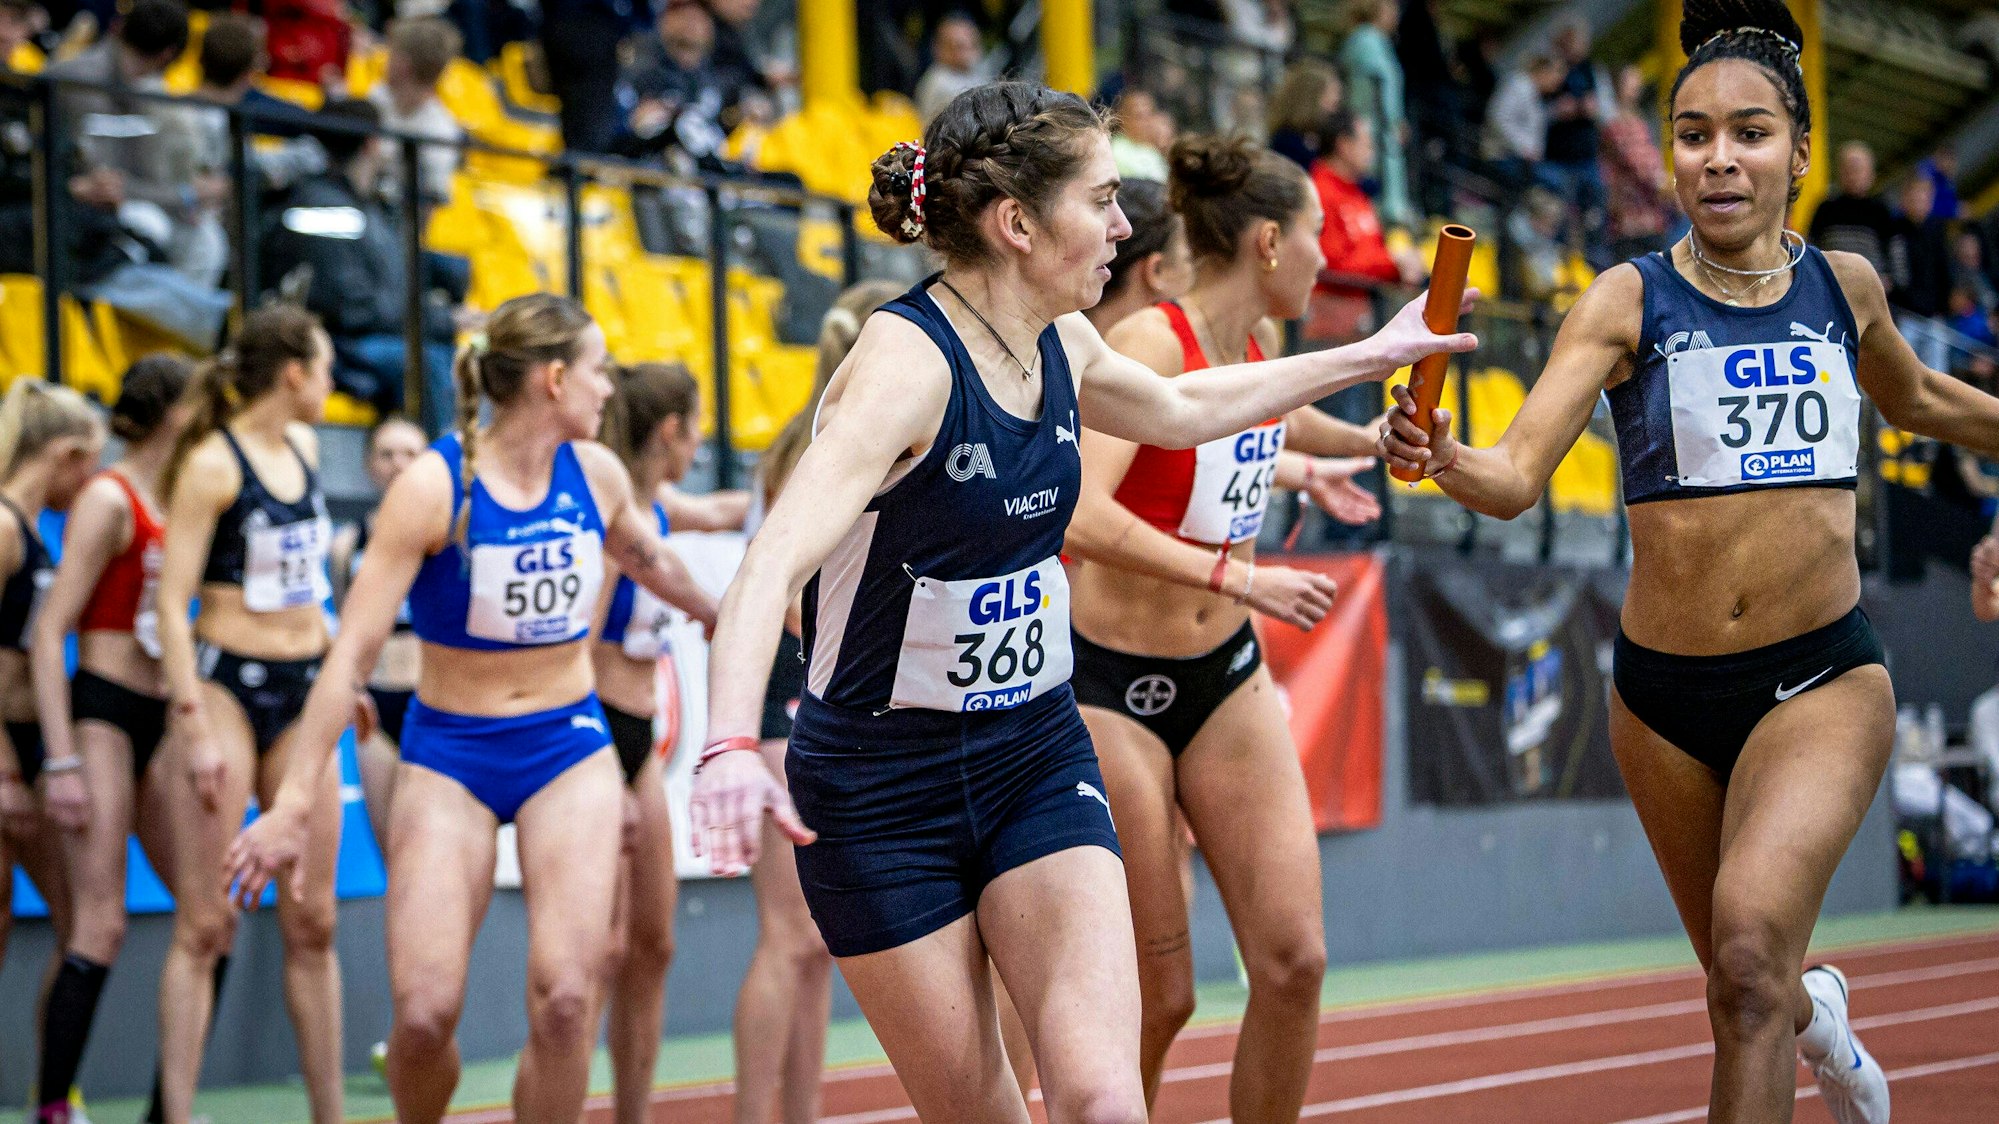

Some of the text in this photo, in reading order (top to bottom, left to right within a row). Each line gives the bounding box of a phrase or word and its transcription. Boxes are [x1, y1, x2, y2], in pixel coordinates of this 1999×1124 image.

[1718, 390, 1830, 449] 370
[1770, 453, 1812, 469] PLAN
[1004, 486, 1059, 517] VIACTIV
[504, 572, 580, 617] 509
[946, 618, 1045, 688] 368
[994, 688, 1029, 707] PLAN
